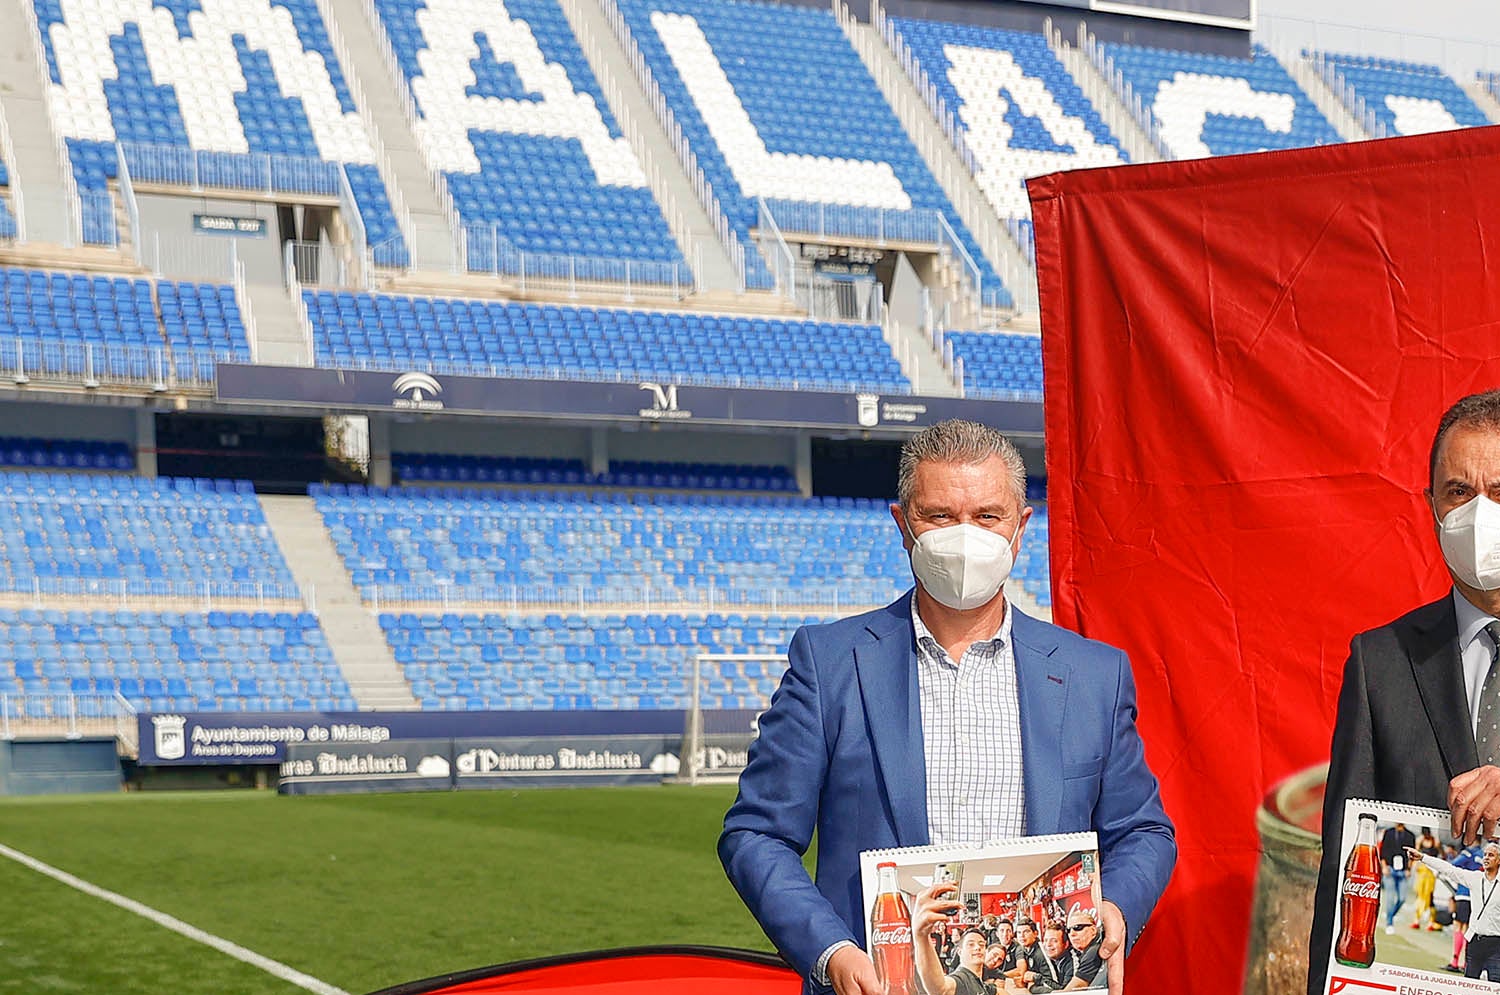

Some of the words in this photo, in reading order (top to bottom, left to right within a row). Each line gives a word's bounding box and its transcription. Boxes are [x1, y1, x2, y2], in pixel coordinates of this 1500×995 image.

[192, 725, 304, 744] Ayuntamiento
[307, 725, 329, 742] de
[331, 724, 390, 743] Málaga
[1388, 969, 1419, 980] SABOREA
[1430, 976, 1457, 986] JUGADA
[1458, 981, 1492, 992] PERFECTA
